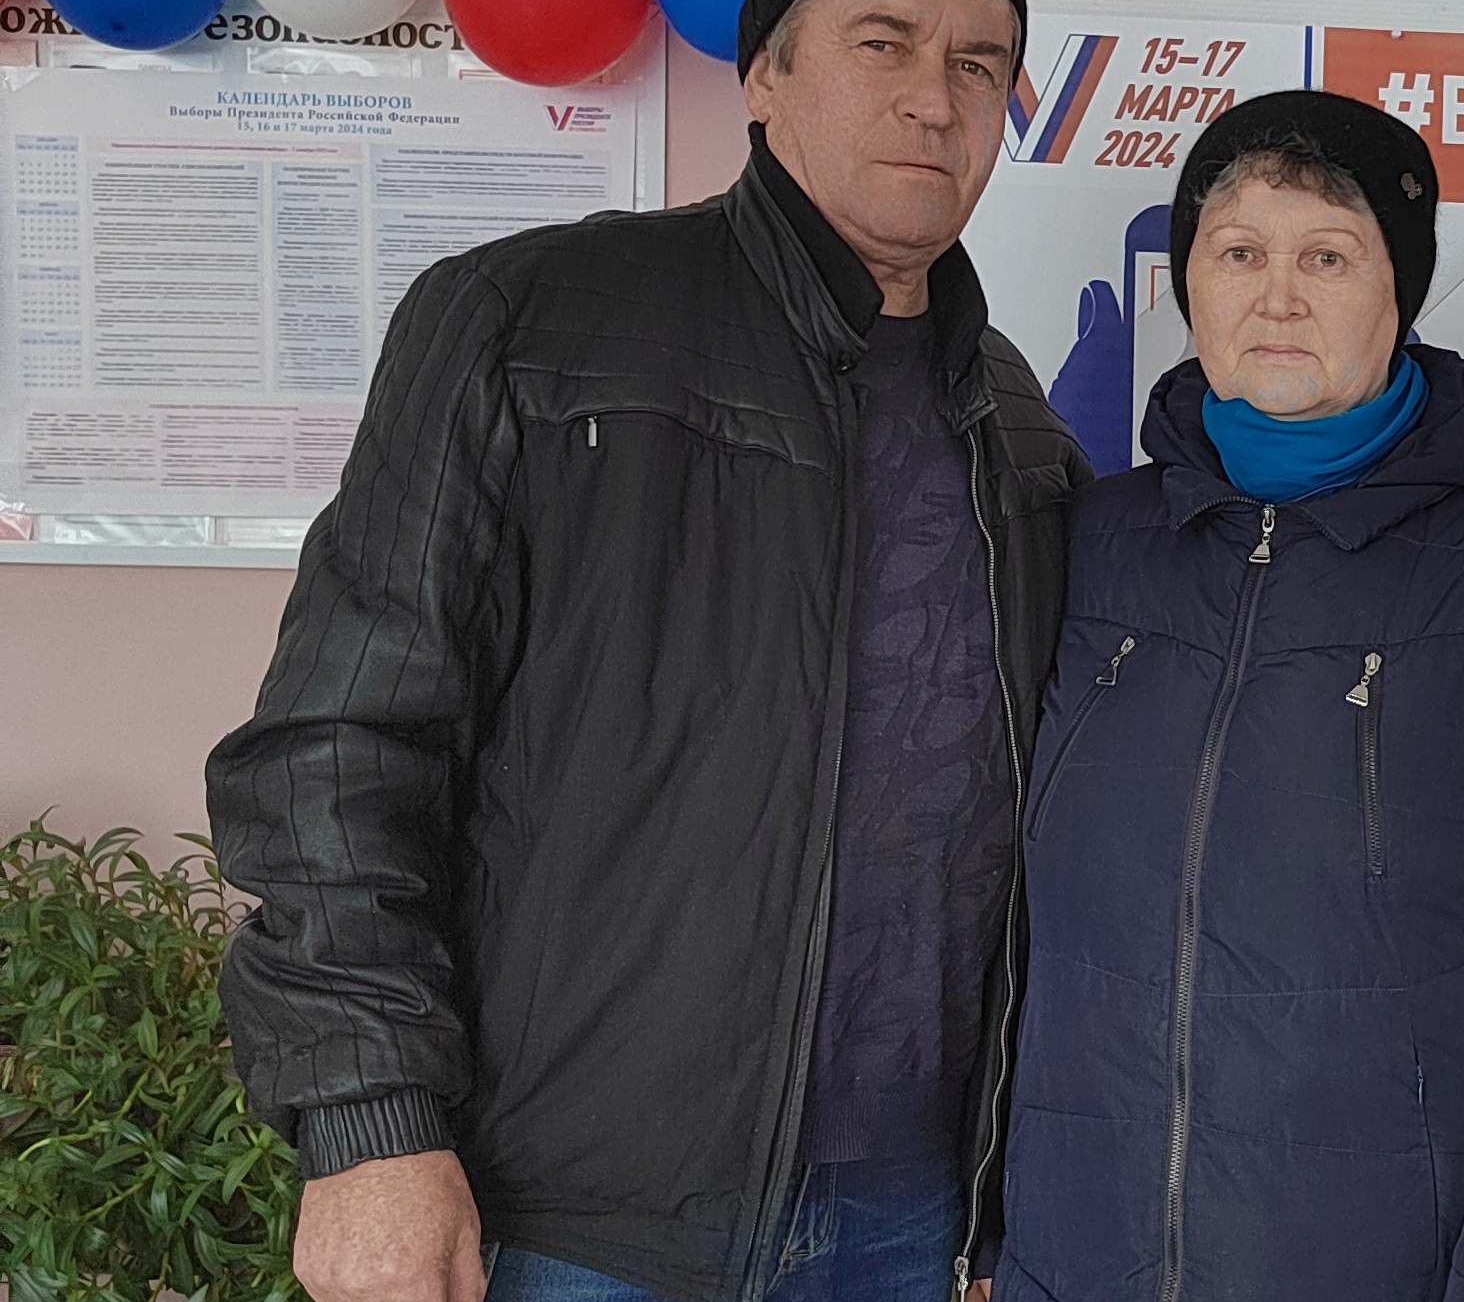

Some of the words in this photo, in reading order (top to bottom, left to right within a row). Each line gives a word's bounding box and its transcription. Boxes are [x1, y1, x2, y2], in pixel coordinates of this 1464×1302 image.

[217, 91, 322, 107] КАЛЕНДАРЬ
[325, 95, 413, 110] ВЫБОРОВ
[1114, 84, 1237, 124] МАРТА
[169, 106, 222, 118] Выборы
[227, 107, 304, 120] Президента
[308, 109, 383, 123] Российской
[388, 112, 460, 125] Федерации
[237, 121, 254, 133] 15,
[257, 121, 270, 132] 16
[273, 124, 281, 132] и
[284, 122, 297, 132] 17
[300, 125, 335, 136] марта
[337, 123, 364, 134] 2024
[367, 126, 393, 136] года
[1095, 130, 1182, 169] 2024
